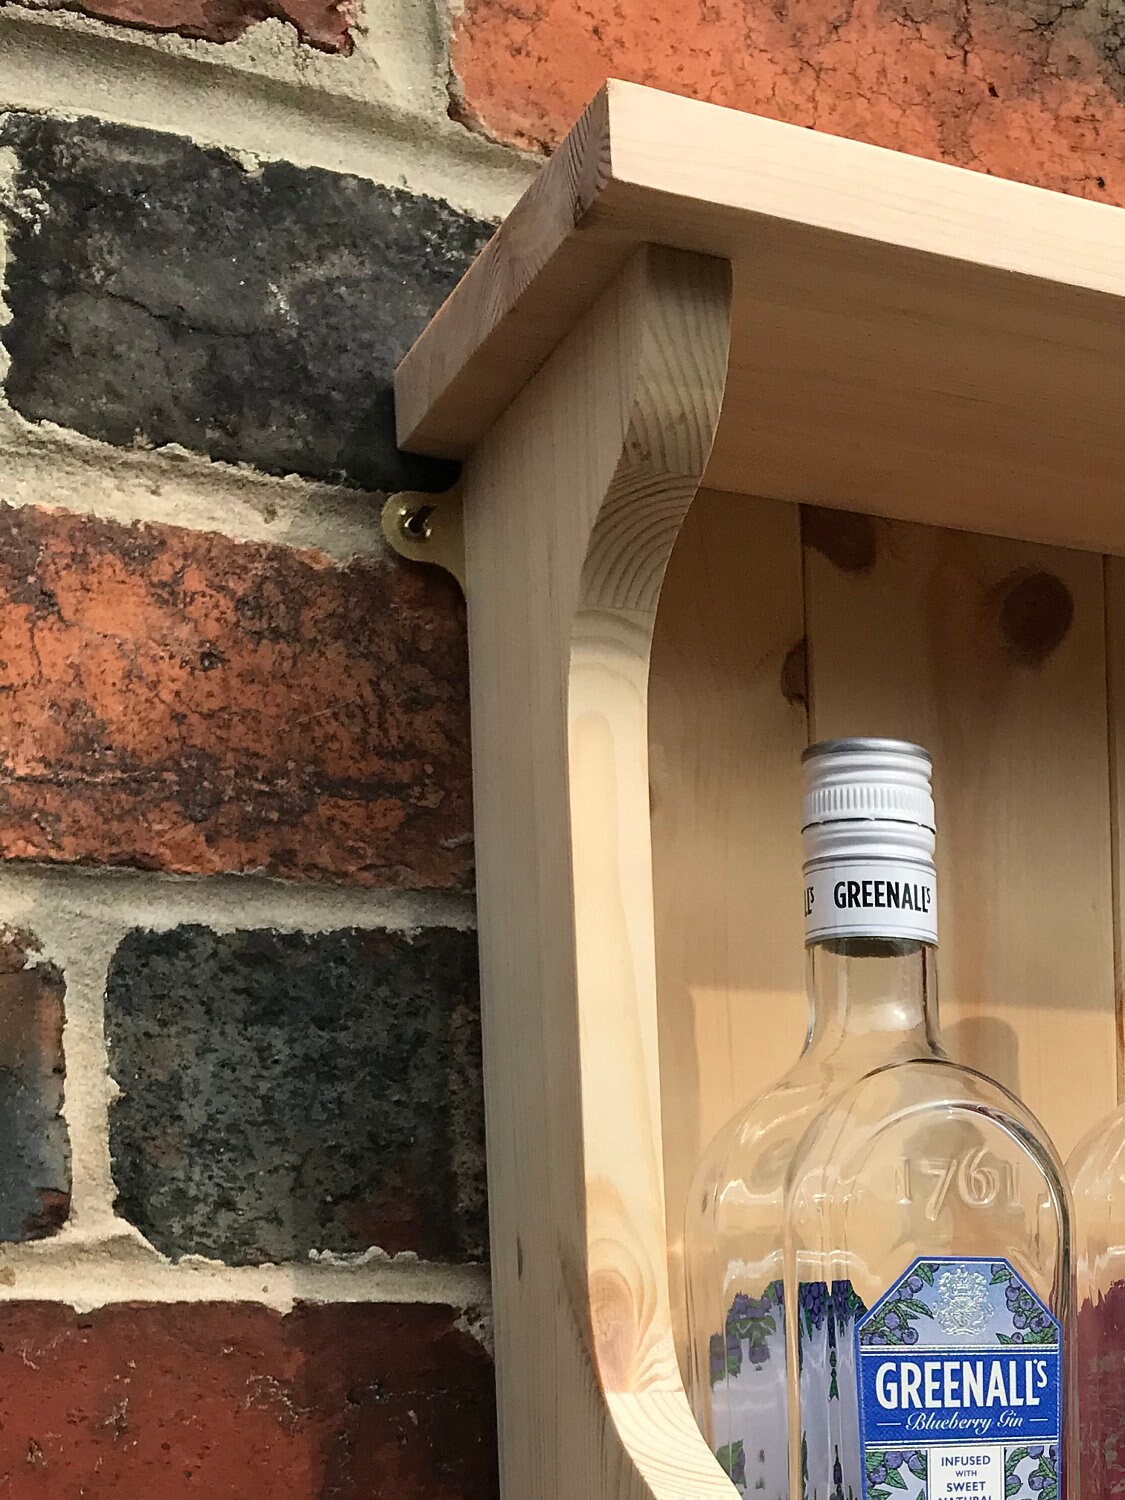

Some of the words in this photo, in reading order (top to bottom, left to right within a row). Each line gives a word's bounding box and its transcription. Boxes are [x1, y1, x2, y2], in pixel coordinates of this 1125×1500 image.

[834, 880, 931, 914] GREENALL'S
[896, 1146, 1025, 1221] 1761
[875, 1359, 1048, 1410] GREENALL'S
[906, 1411, 993, 1435] Blueberry
[997, 1410, 1024, 1428] Gin
[941, 1455, 991, 1467] INFUSED
[946, 1481, 987, 1493] SWEET
